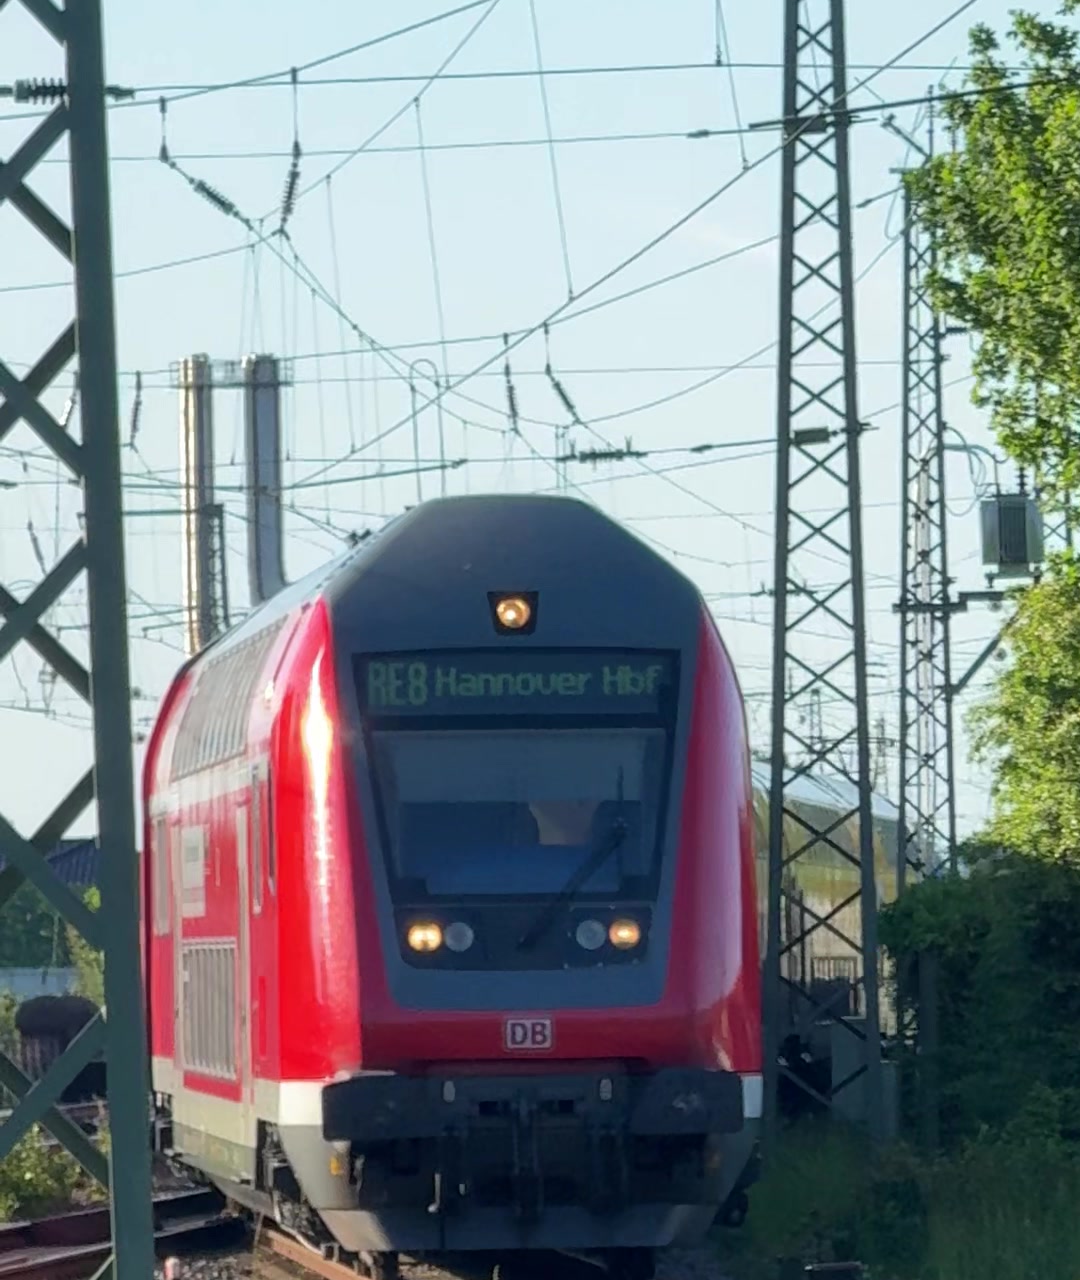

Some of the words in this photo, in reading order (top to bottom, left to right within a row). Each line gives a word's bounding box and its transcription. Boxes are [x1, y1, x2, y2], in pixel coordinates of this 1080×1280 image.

[367, 662, 428, 706] RE8
[435, 667, 591, 697] Hannover
[602, 665, 661, 696] Hbf
[509, 1022, 548, 1046] DB
